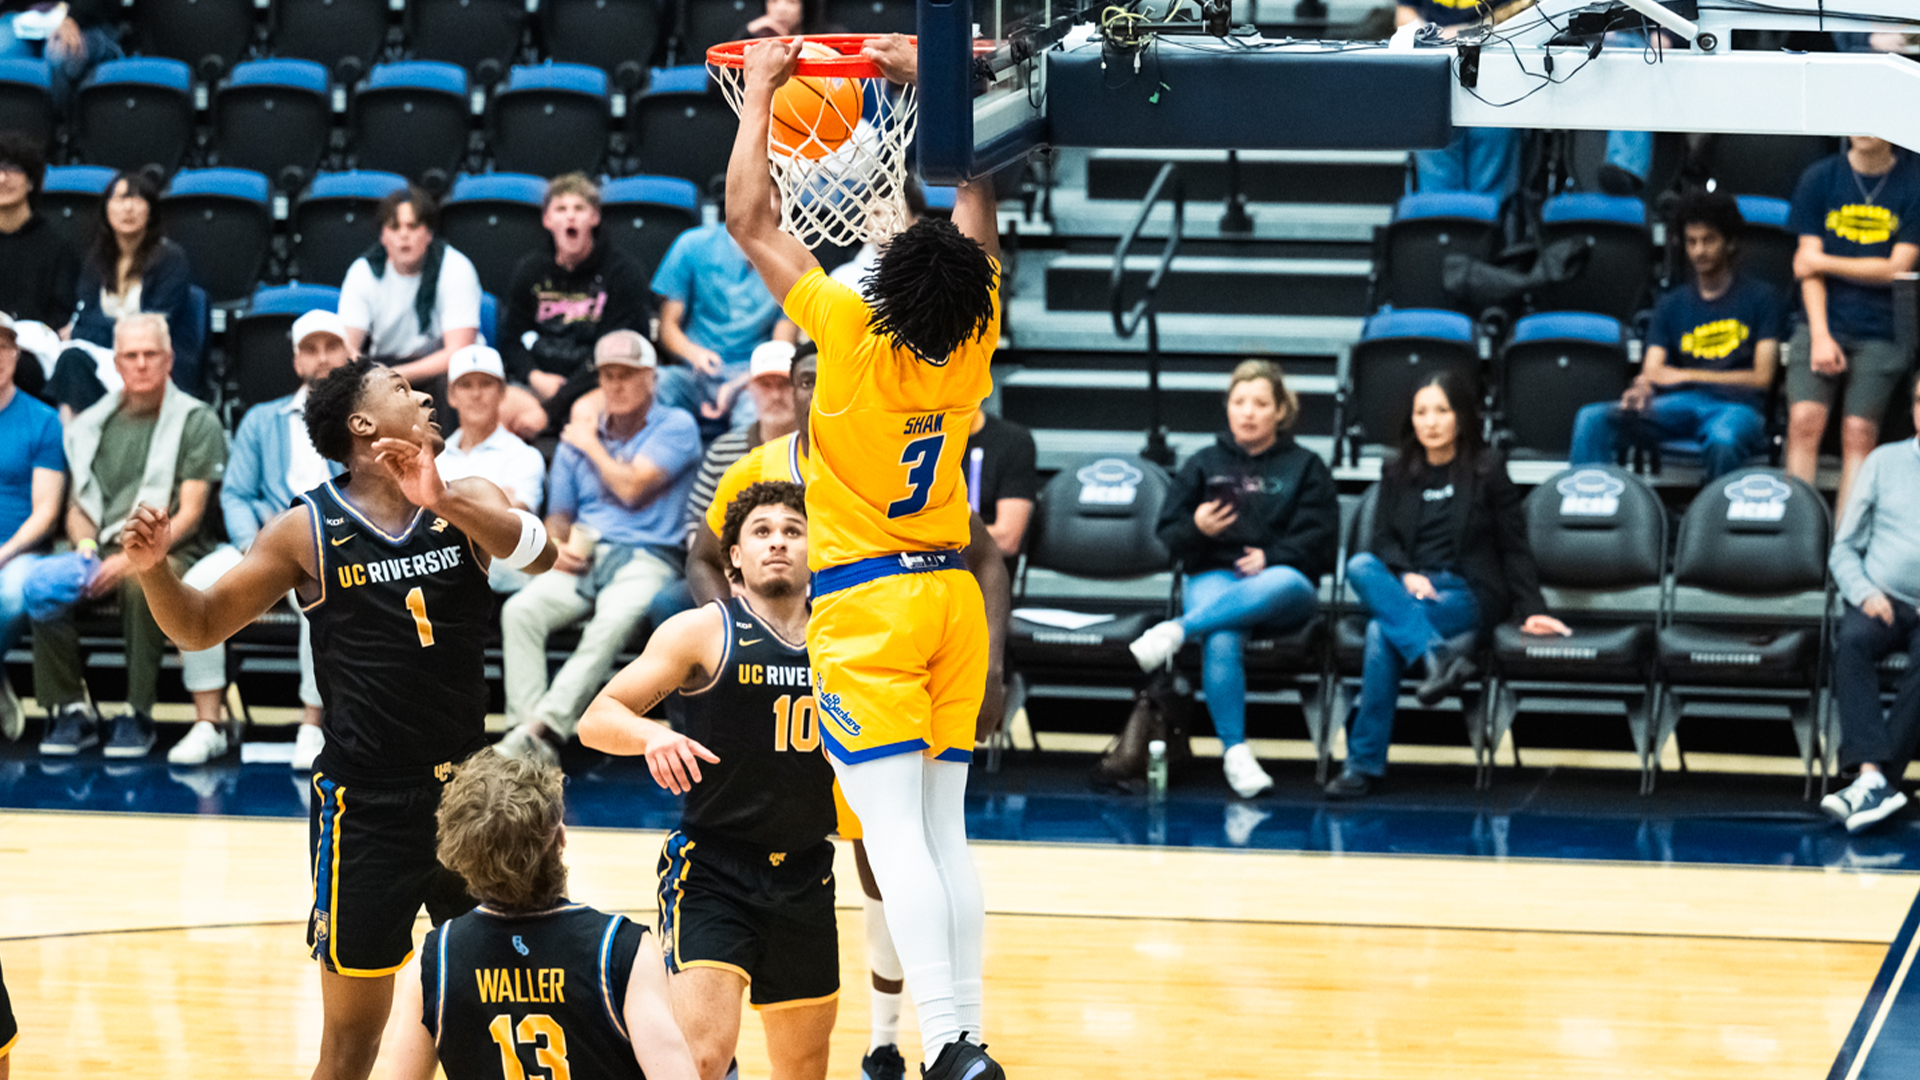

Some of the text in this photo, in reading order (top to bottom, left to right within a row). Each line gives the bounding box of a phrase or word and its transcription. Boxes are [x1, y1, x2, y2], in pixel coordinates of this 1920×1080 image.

[903, 412, 946, 434] SHAW
[887, 433, 947, 519] 3
[338, 563, 366, 589] UC
[405, 586, 435, 648] 1
[738, 664, 764, 685] UC
[773, 694, 820, 752] 10
[475, 968, 565, 1003] WALLER
[488, 1013, 572, 1080] 13
